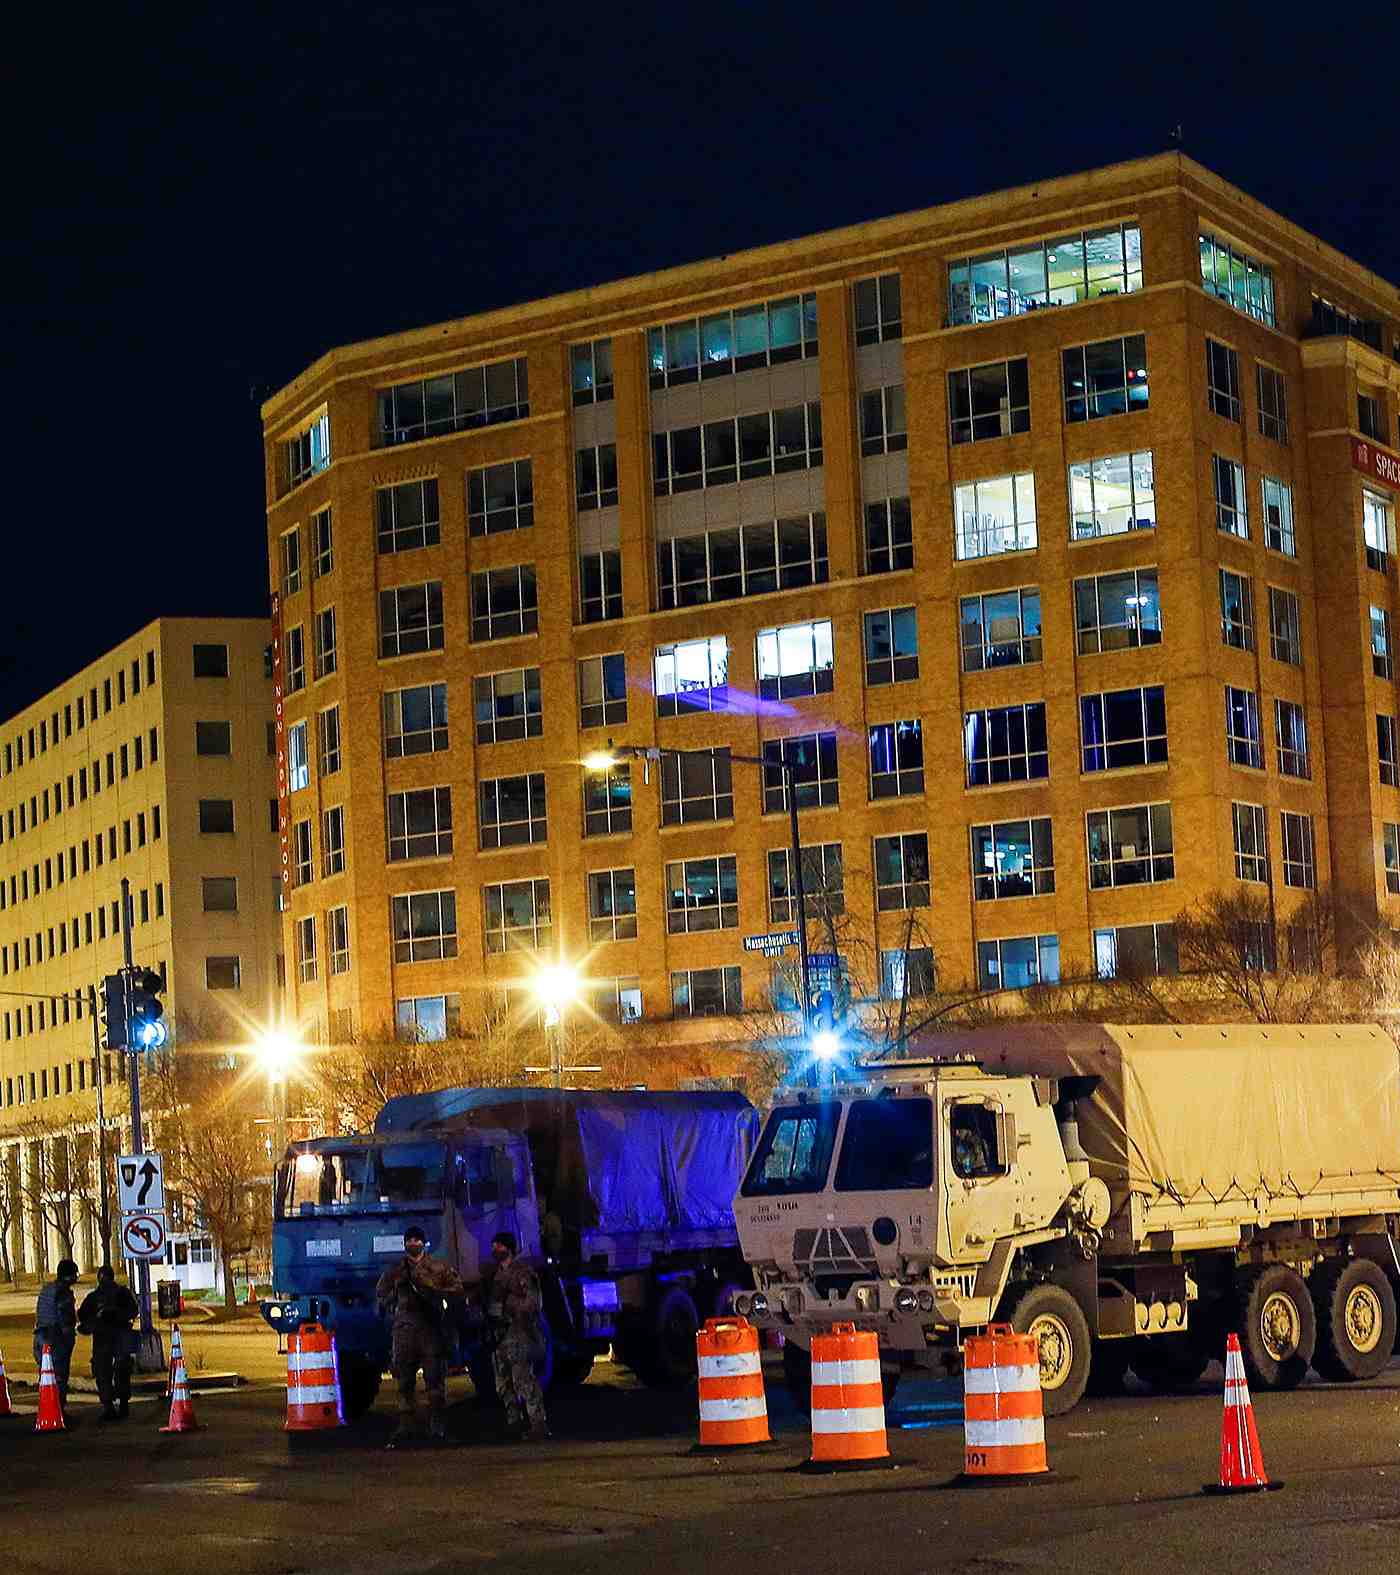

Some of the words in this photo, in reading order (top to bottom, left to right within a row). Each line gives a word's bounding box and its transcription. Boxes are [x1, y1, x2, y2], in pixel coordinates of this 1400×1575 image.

[275, 685, 283, 735] 202
[280, 816, 289, 883] 2100
[744, 931, 791, 951] Massachusetts
